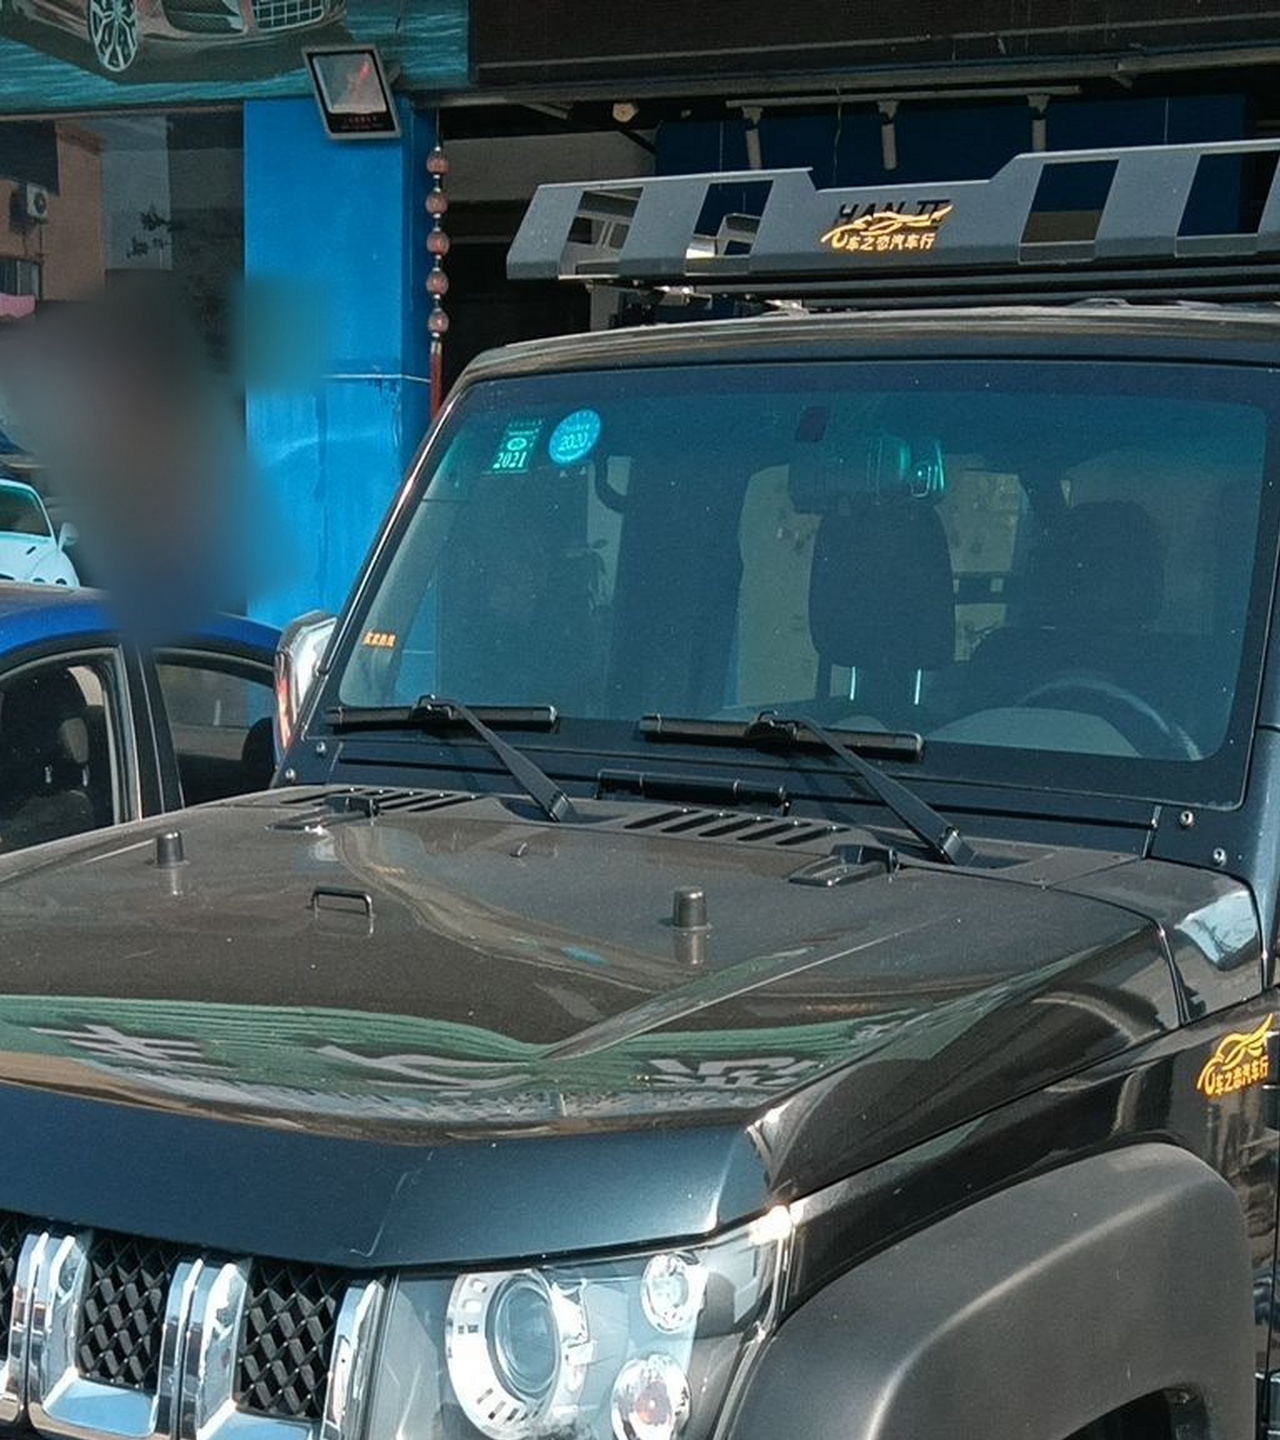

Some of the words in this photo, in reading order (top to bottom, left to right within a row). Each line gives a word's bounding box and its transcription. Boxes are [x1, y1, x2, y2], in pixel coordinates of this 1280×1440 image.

[845, 231, 936, 251] 车之恋汽车行
[492, 450, 527, 469] 2021
